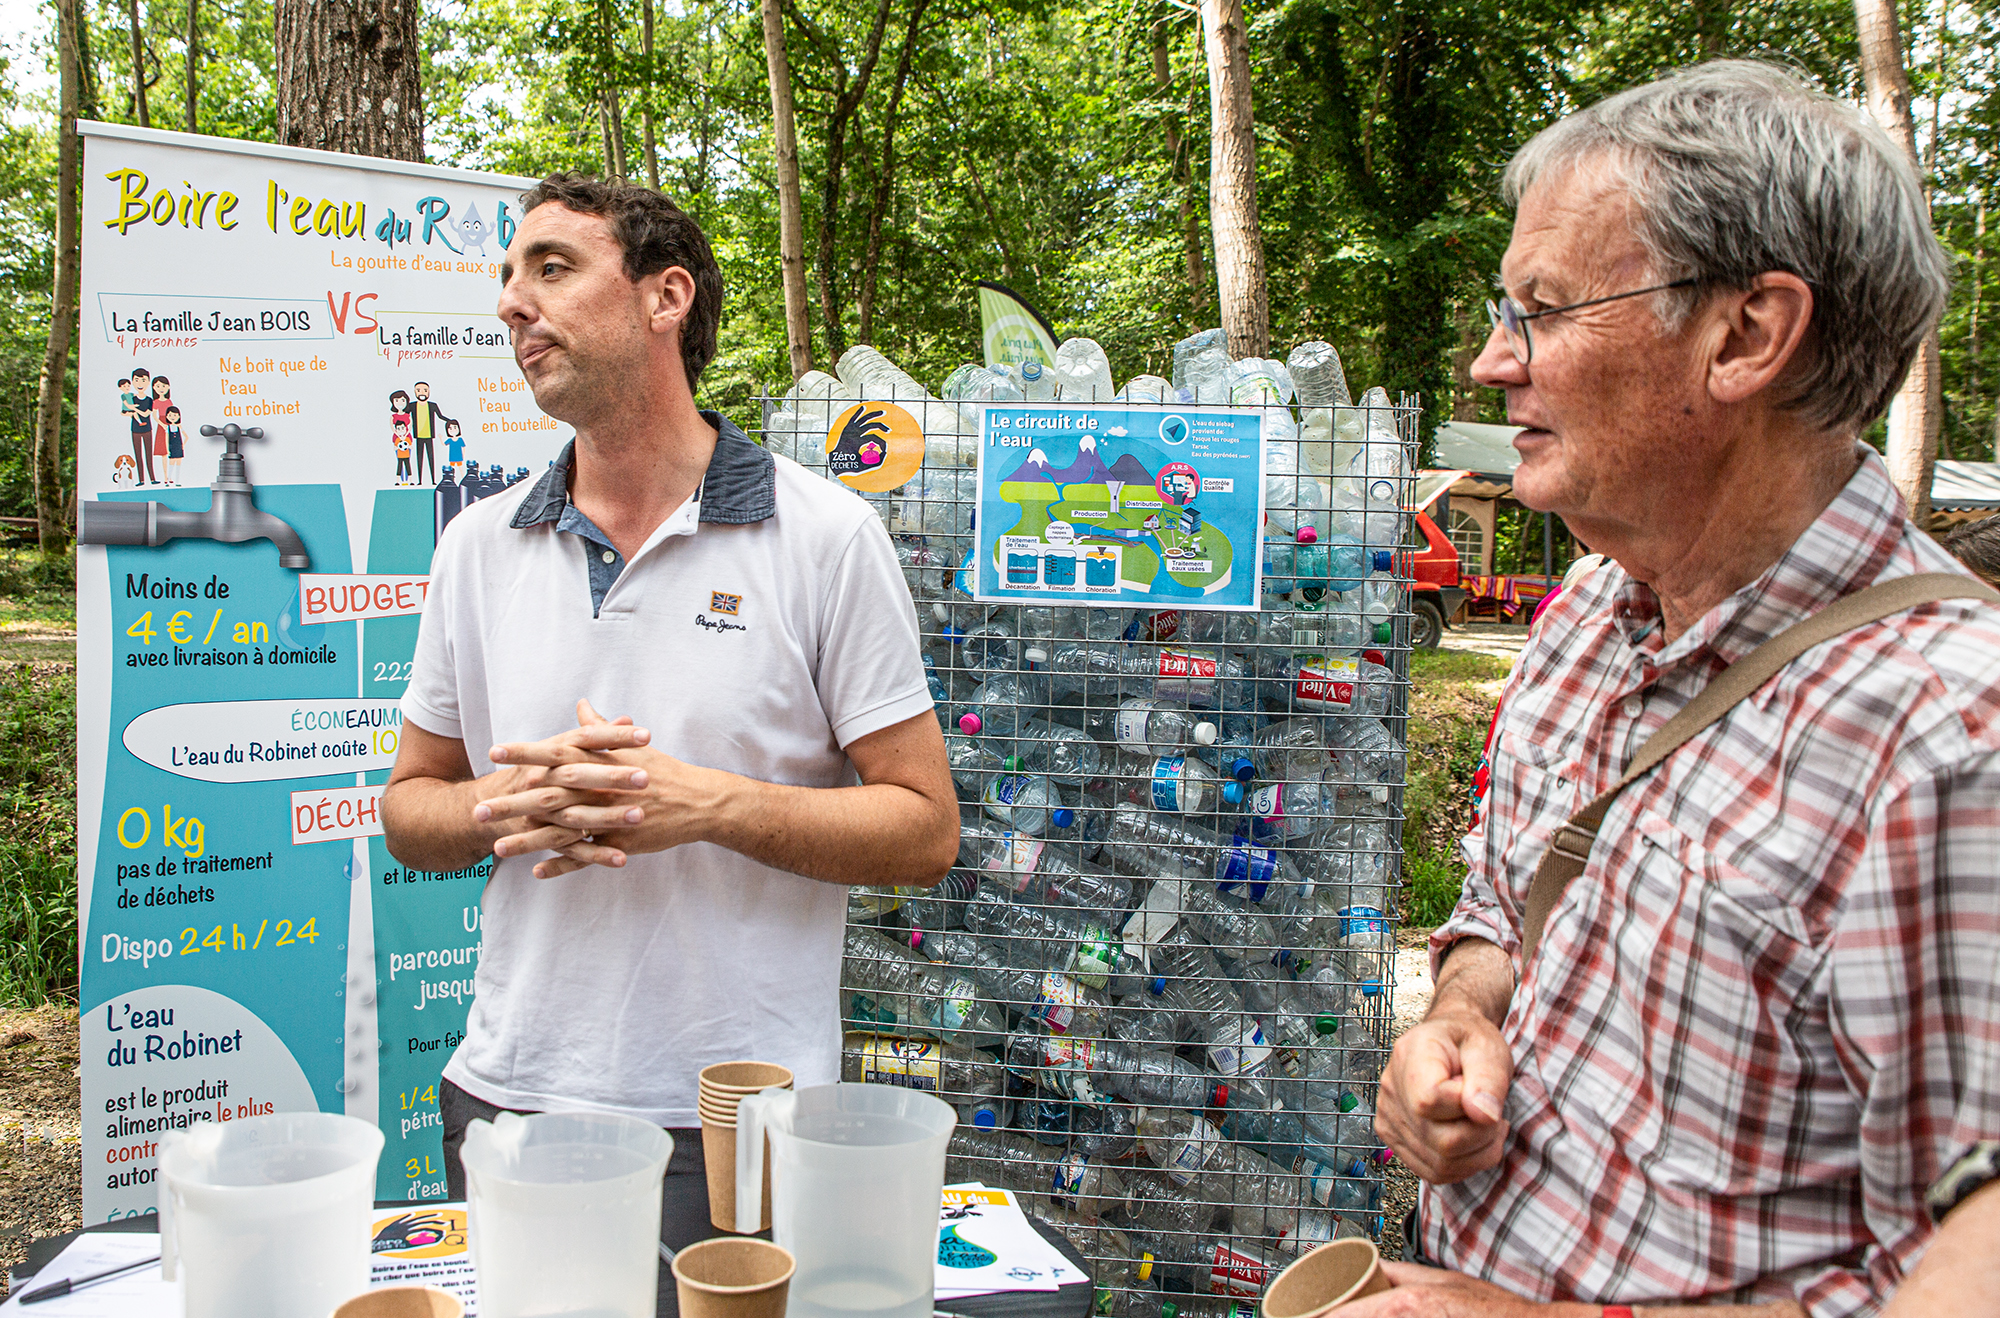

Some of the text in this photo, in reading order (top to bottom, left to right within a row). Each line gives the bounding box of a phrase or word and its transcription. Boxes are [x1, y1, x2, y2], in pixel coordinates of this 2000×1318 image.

[103, 166, 239, 236] Boire
[266, 179, 367, 241] l'eau
[374, 208, 411, 249] du
[330, 250, 502, 279] La goutte d'eau aux gr
[112, 310, 311, 334] La famille Jean BOIS
[326, 290, 379, 335] VS
[116, 334, 198, 360] 4 personnes
[379, 327, 403, 347] La
[405, 325, 459, 347] famille
[462, 327, 505, 347] Jean
[220, 354, 329, 380] Ne boit que de
[383, 347, 454, 366] 4 personnes
[221, 379, 257, 396] l'eau
[478, 376, 526, 393] Ne boit
[223, 398, 301, 418] du robinet
[479, 397, 511, 413] l'eau
[482, 415, 558, 433] en bouteille
[990, 413, 1099, 431] Le circuit de
[989, 430, 1034, 448] l'eau
[830, 460, 859, 471] DÉCHETS
[831, 450, 857, 463] Zéro
[126, 574, 231, 600] Moins de
[306, 582, 430, 615] BUDGET
[1085, 586, 1117, 594] Chloration
[126, 608, 269, 645] 4 € / an
[695, 614, 747, 633] Pepe Jeans
[126, 645, 338, 668] avec livraison à domicile
[1164, 659, 1202, 677] Vittel
[1301, 681, 1337, 700] Vittel
[171, 745, 221, 767] L'eau
[223, 743, 245, 764] du
[249, 740, 318, 763] Robinet
[322, 739, 368, 759] coûte
[295, 796, 383, 835] DÉCH
[117, 804, 206, 858] 0 kg
[117, 852, 274, 886] pas de traitement
[384, 868, 399, 885] et
[403, 866, 417, 884] le
[117, 884, 215, 910] de déchets
[102, 917, 320, 969] Dispo 24 h / 24
[414, 978, 476, 1011] jusqu
[106, 1004, 174, 1032] L'eau
[107, 1029, 243, 1067] du Robinet
[408, 1030, 466, 1054] Pour fab
[105, 1079, 229, 1114] est le produit
[400, 1084, 437, 1110] 1/4
[106, 1098, 274, 1139] alimentaire le plus
[401, 1111, 443, 1139] pétro
[106, 1140, 159, 1164] contr
[106, 1167, 159, 1189] autor
[405, 1155, 437, 1178] 3 L
[966, 1193, 990, 1204] du
